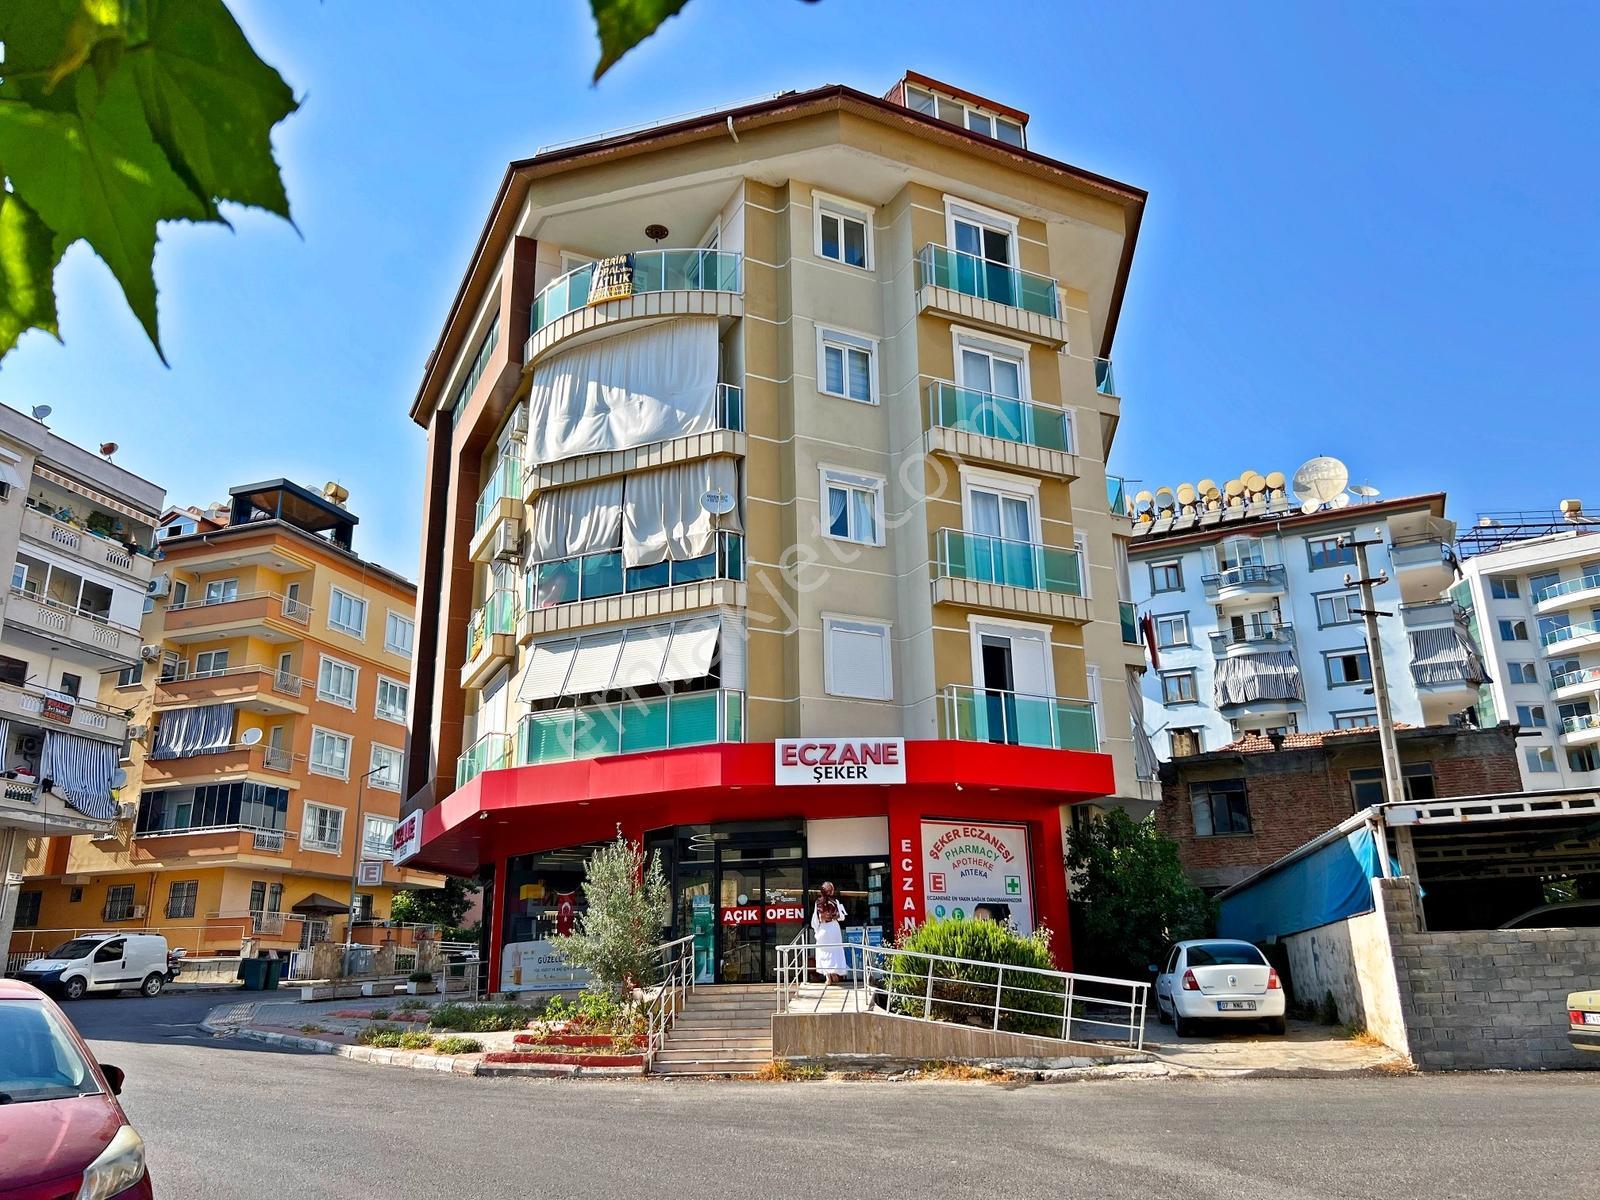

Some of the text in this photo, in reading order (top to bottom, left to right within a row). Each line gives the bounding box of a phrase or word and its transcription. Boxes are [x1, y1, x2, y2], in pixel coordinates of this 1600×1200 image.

[782, 743, 899, 766] ECZANE
[813, 766, 868, 783] ŞEKER
[929, 829, 961, 860] ŞEKER
[945, 844, 1000, 862] PHARMACY
[952, 857, 994, 872] APOTHEKE
[365, 867, 377, 881] E
[932, 875, 943, 890] E
[724, 908, 805, 923] AÇIK OPEN
